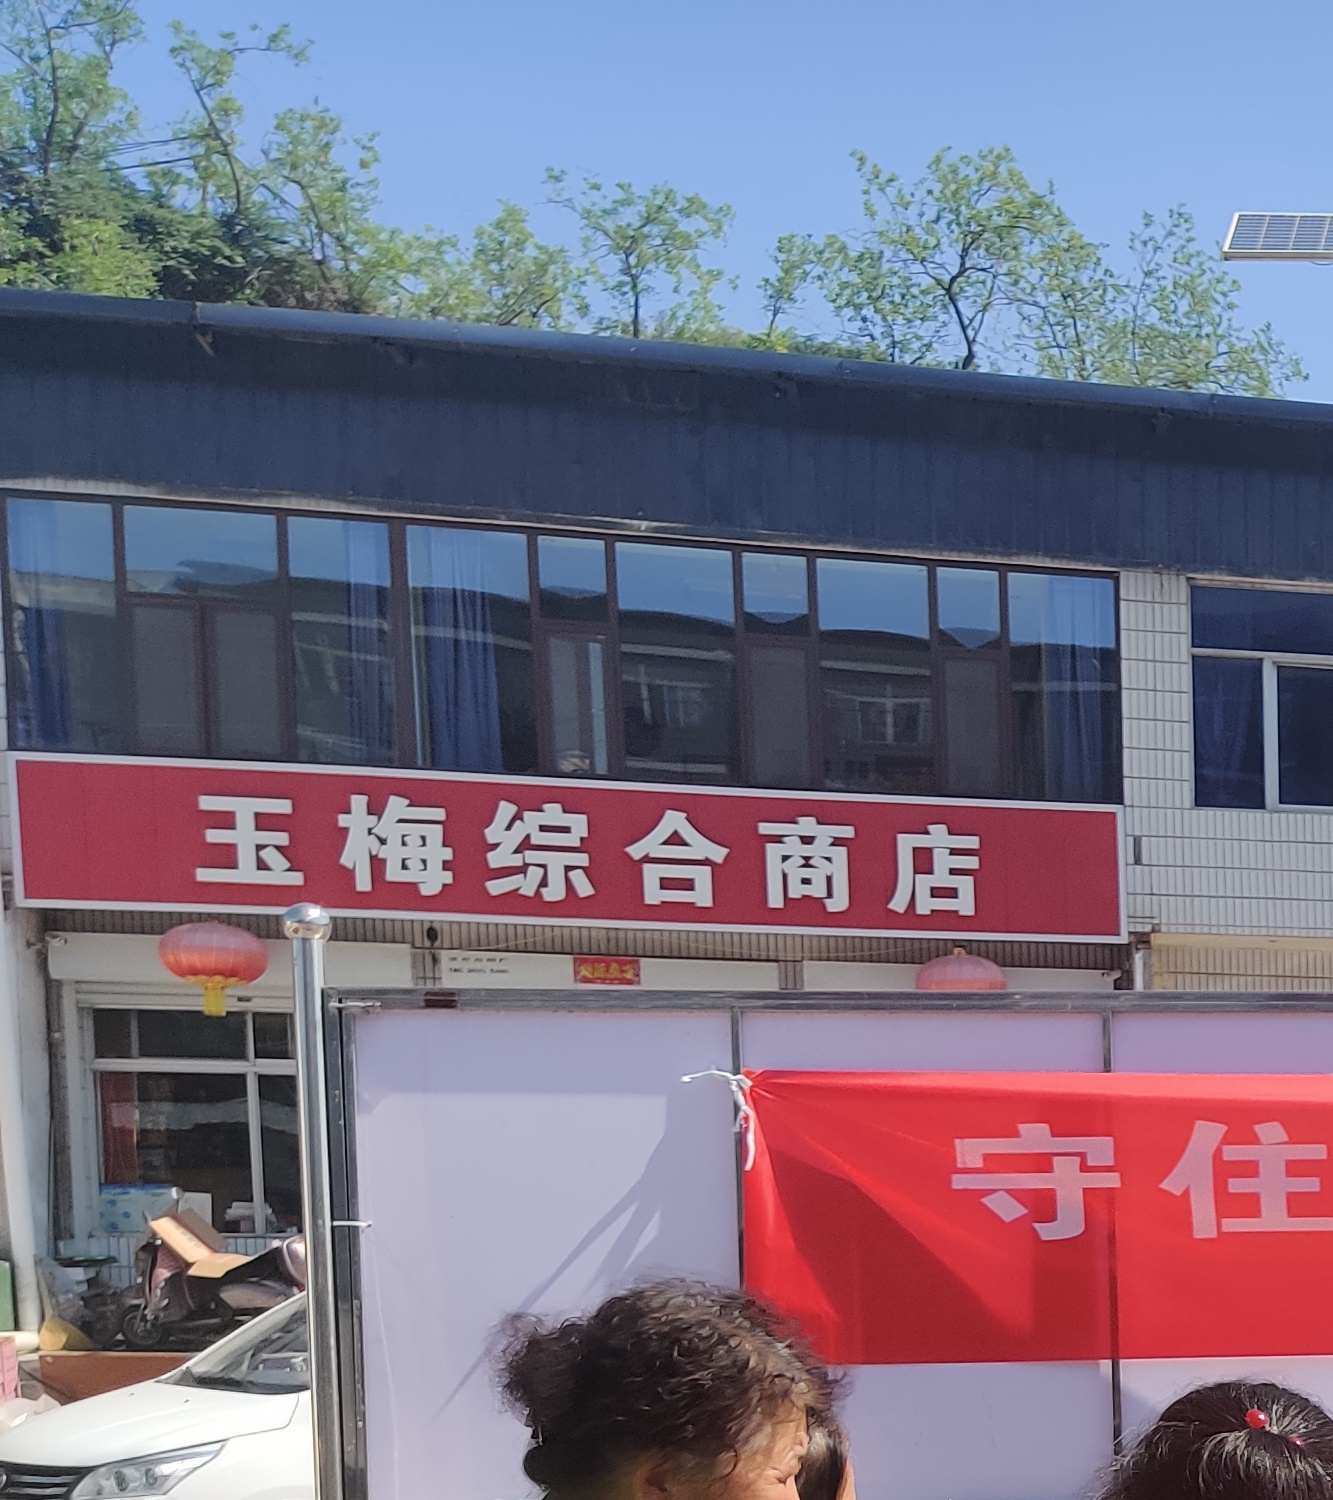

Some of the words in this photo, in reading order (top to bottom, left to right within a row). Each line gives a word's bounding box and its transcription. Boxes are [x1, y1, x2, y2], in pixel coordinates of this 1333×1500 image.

[195, 794, 981, 918] 玉梅综合商店
